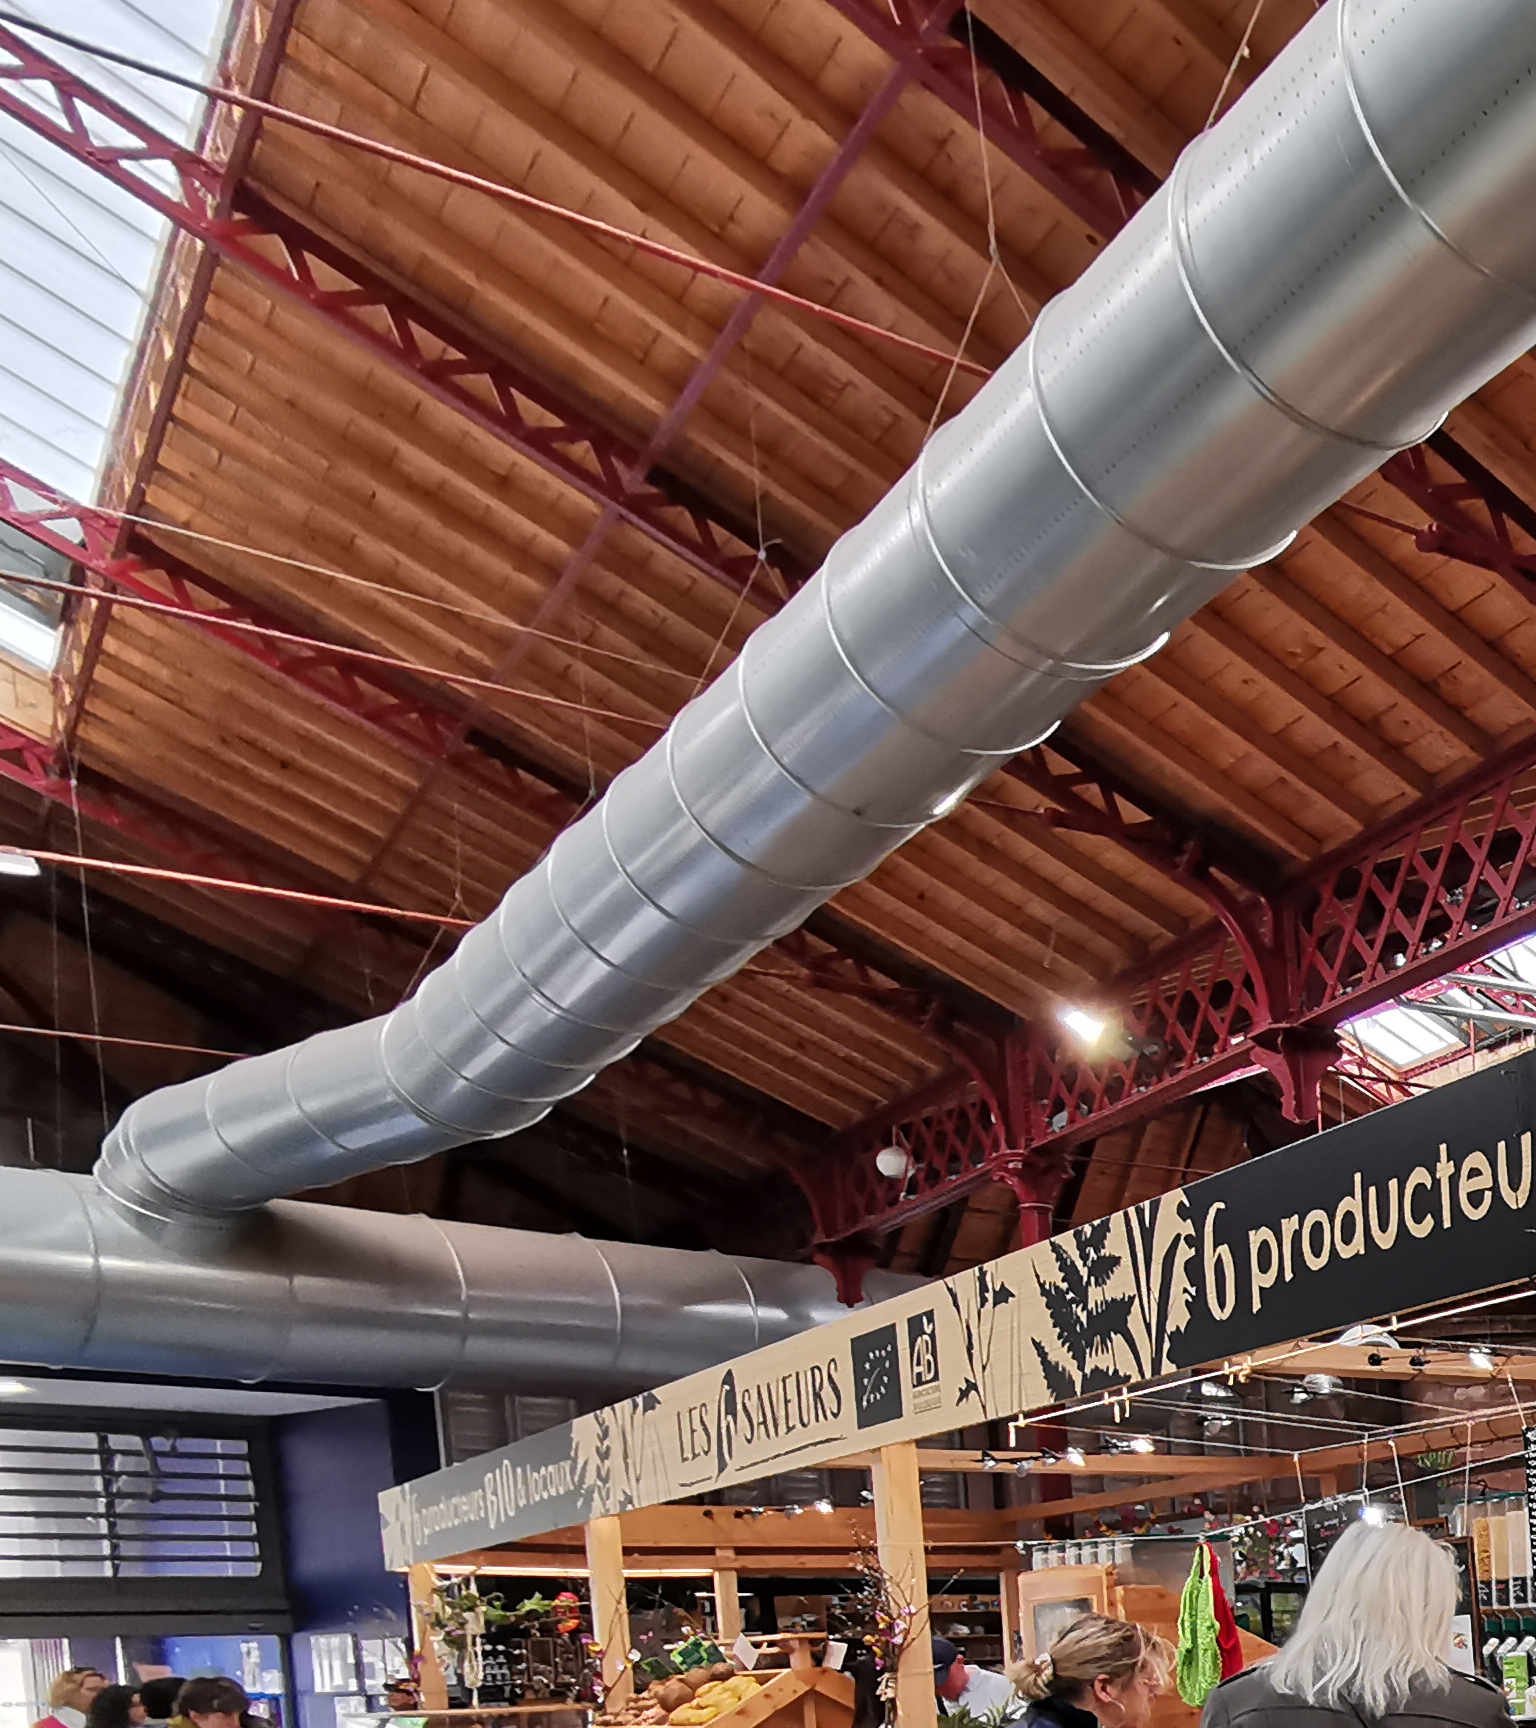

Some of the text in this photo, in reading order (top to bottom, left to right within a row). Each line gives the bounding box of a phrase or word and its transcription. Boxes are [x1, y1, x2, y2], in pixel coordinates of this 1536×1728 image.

[1204, 1202, 1237, 1322] 6
[913, 1334, 935, 1386] AB
[677, 1402, 712, 1463] LES
[740, 1357, 843, 1444] SAVEURS
[411, 1493, 423, 1546] 6
[422, 1489, 485, 1545] producteurs
[484, 1459, 516, 1530] BIO
[527, 1460, 575, 1504] locaux
